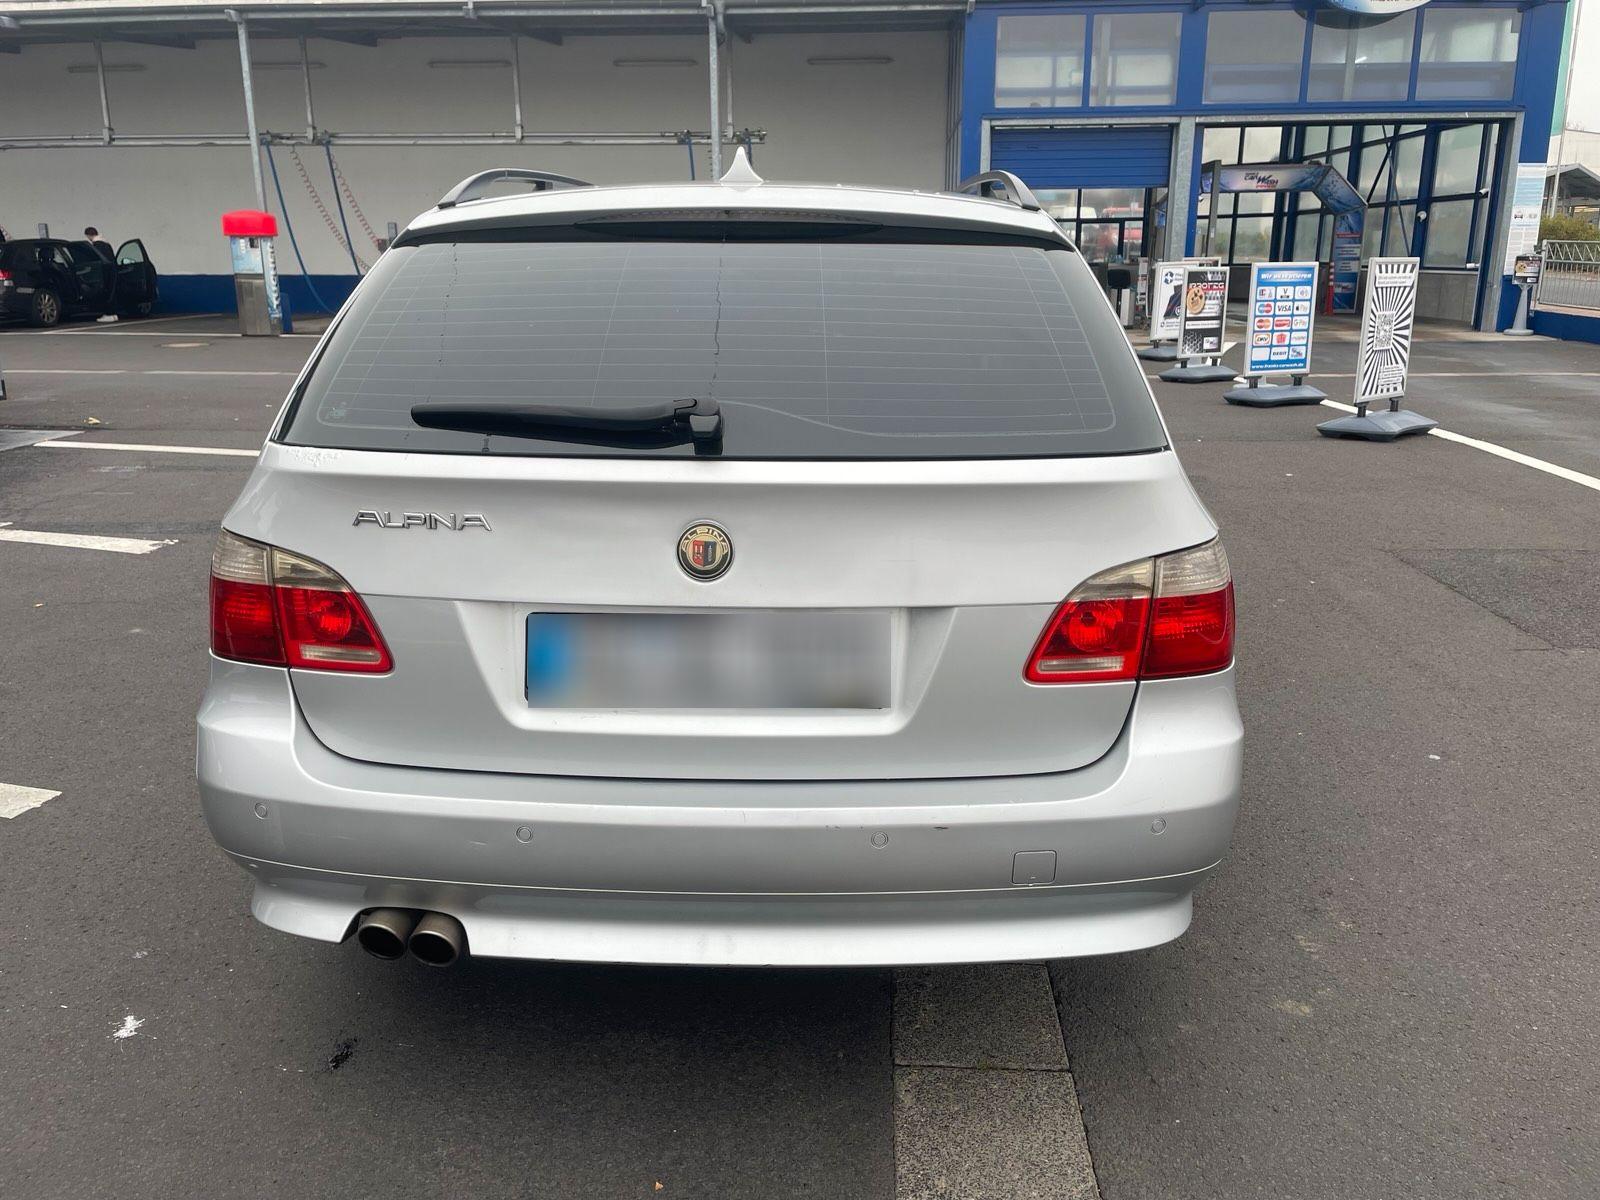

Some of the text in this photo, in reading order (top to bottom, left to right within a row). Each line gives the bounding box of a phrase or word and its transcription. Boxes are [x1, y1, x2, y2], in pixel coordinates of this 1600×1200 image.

[1277, 304, 1292, 312] VISA
[352, 509, 493, 531] ALPINA
[681, 527, 729, 555] ALPINA
